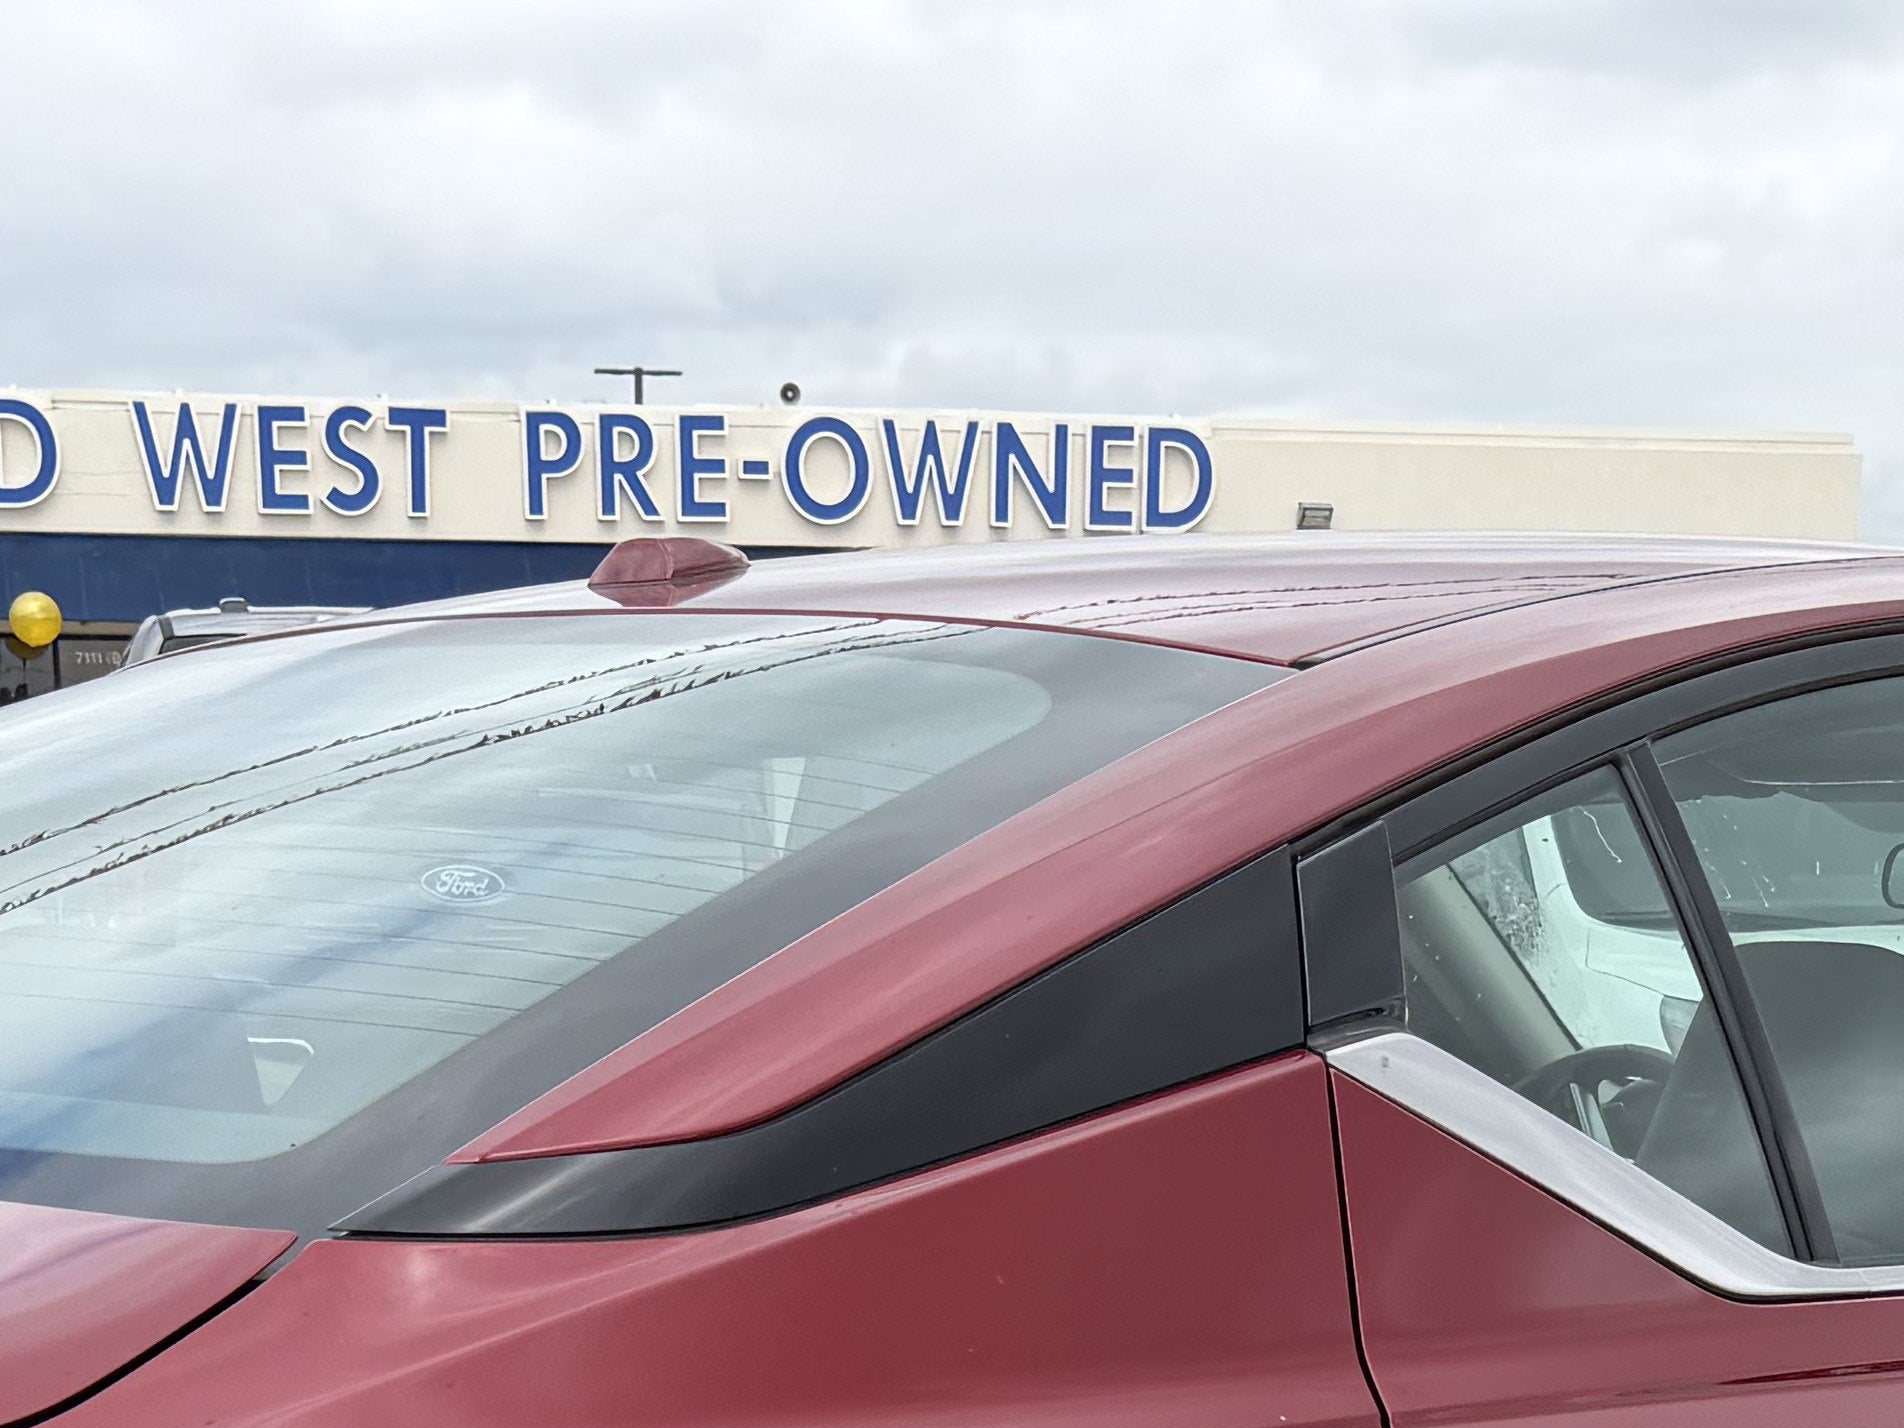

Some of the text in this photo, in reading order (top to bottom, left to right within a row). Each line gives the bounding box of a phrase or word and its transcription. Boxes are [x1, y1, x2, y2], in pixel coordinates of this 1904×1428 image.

[130, 398, 450, 518] WEST
[520, 409, 1216, 533] PRE-OWNED
[437, 869, 489, 897] Ford
